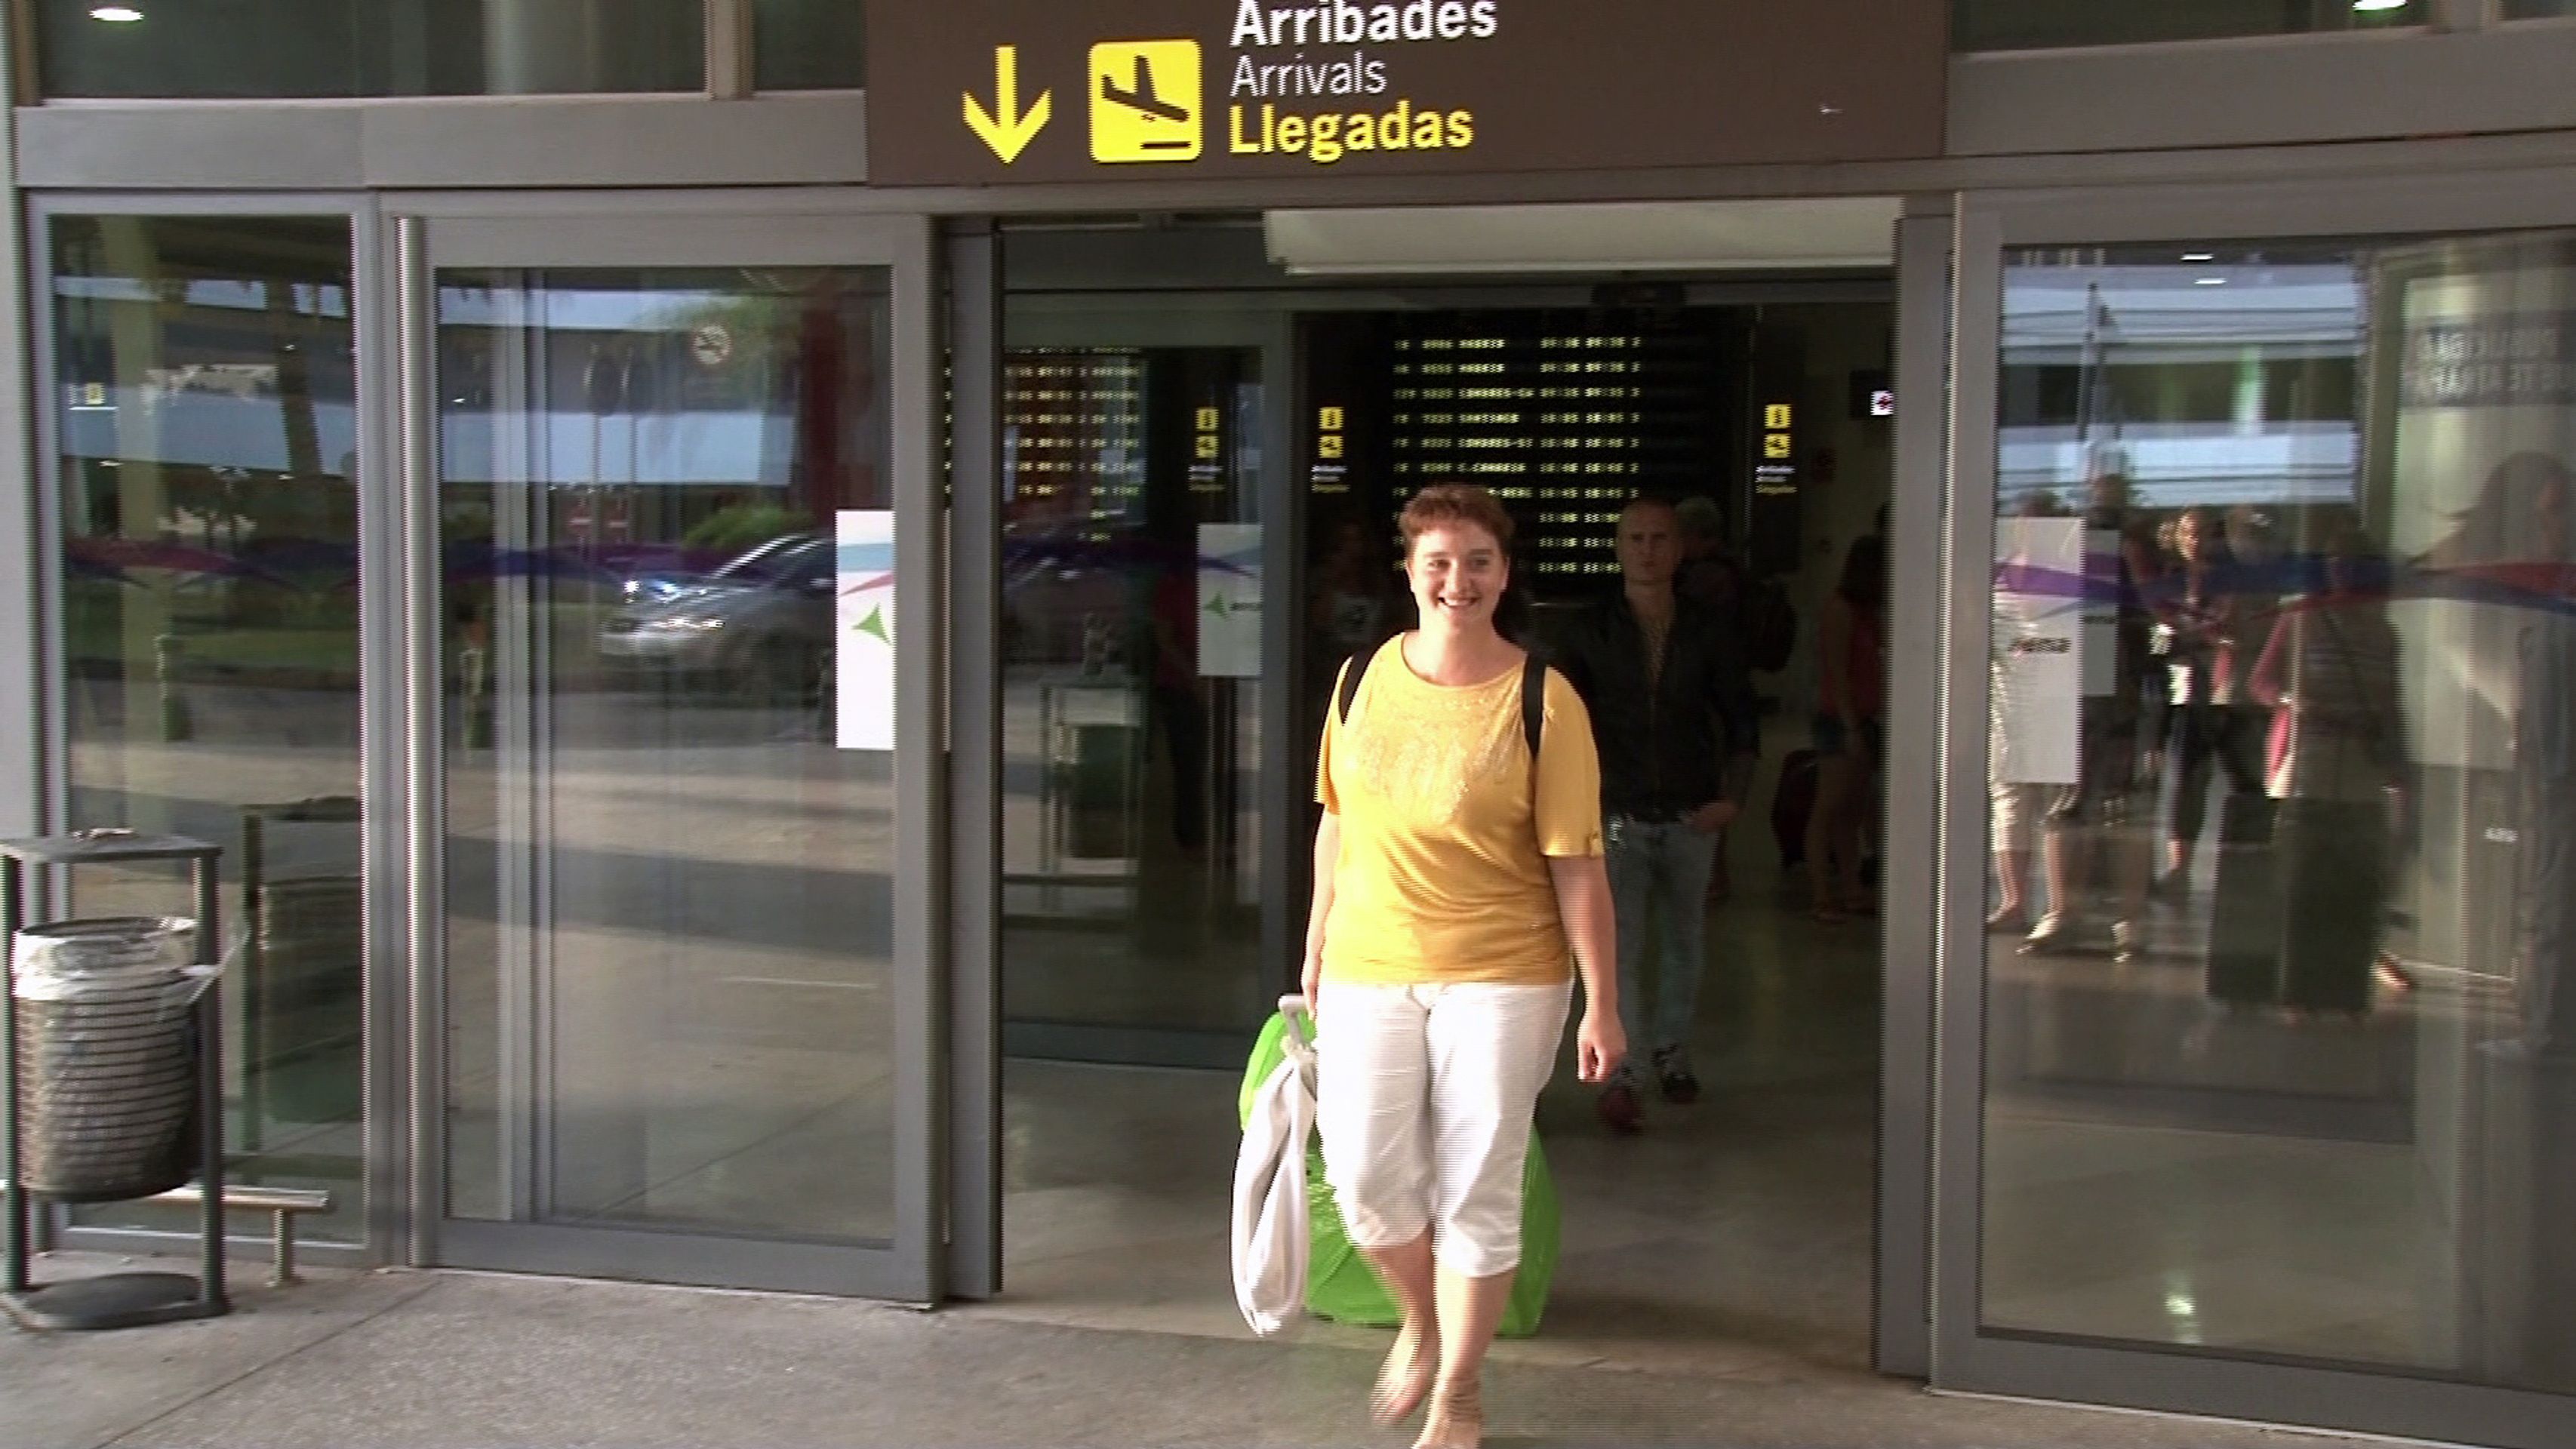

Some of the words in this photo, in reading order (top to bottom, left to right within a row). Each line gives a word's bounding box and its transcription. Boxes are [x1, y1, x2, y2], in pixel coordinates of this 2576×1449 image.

[1230, 0, 1498, 46] Arribades
[1230, 50, 1387, 97] Arrivals
[1229, 98, 1474, 163] Llegadas
